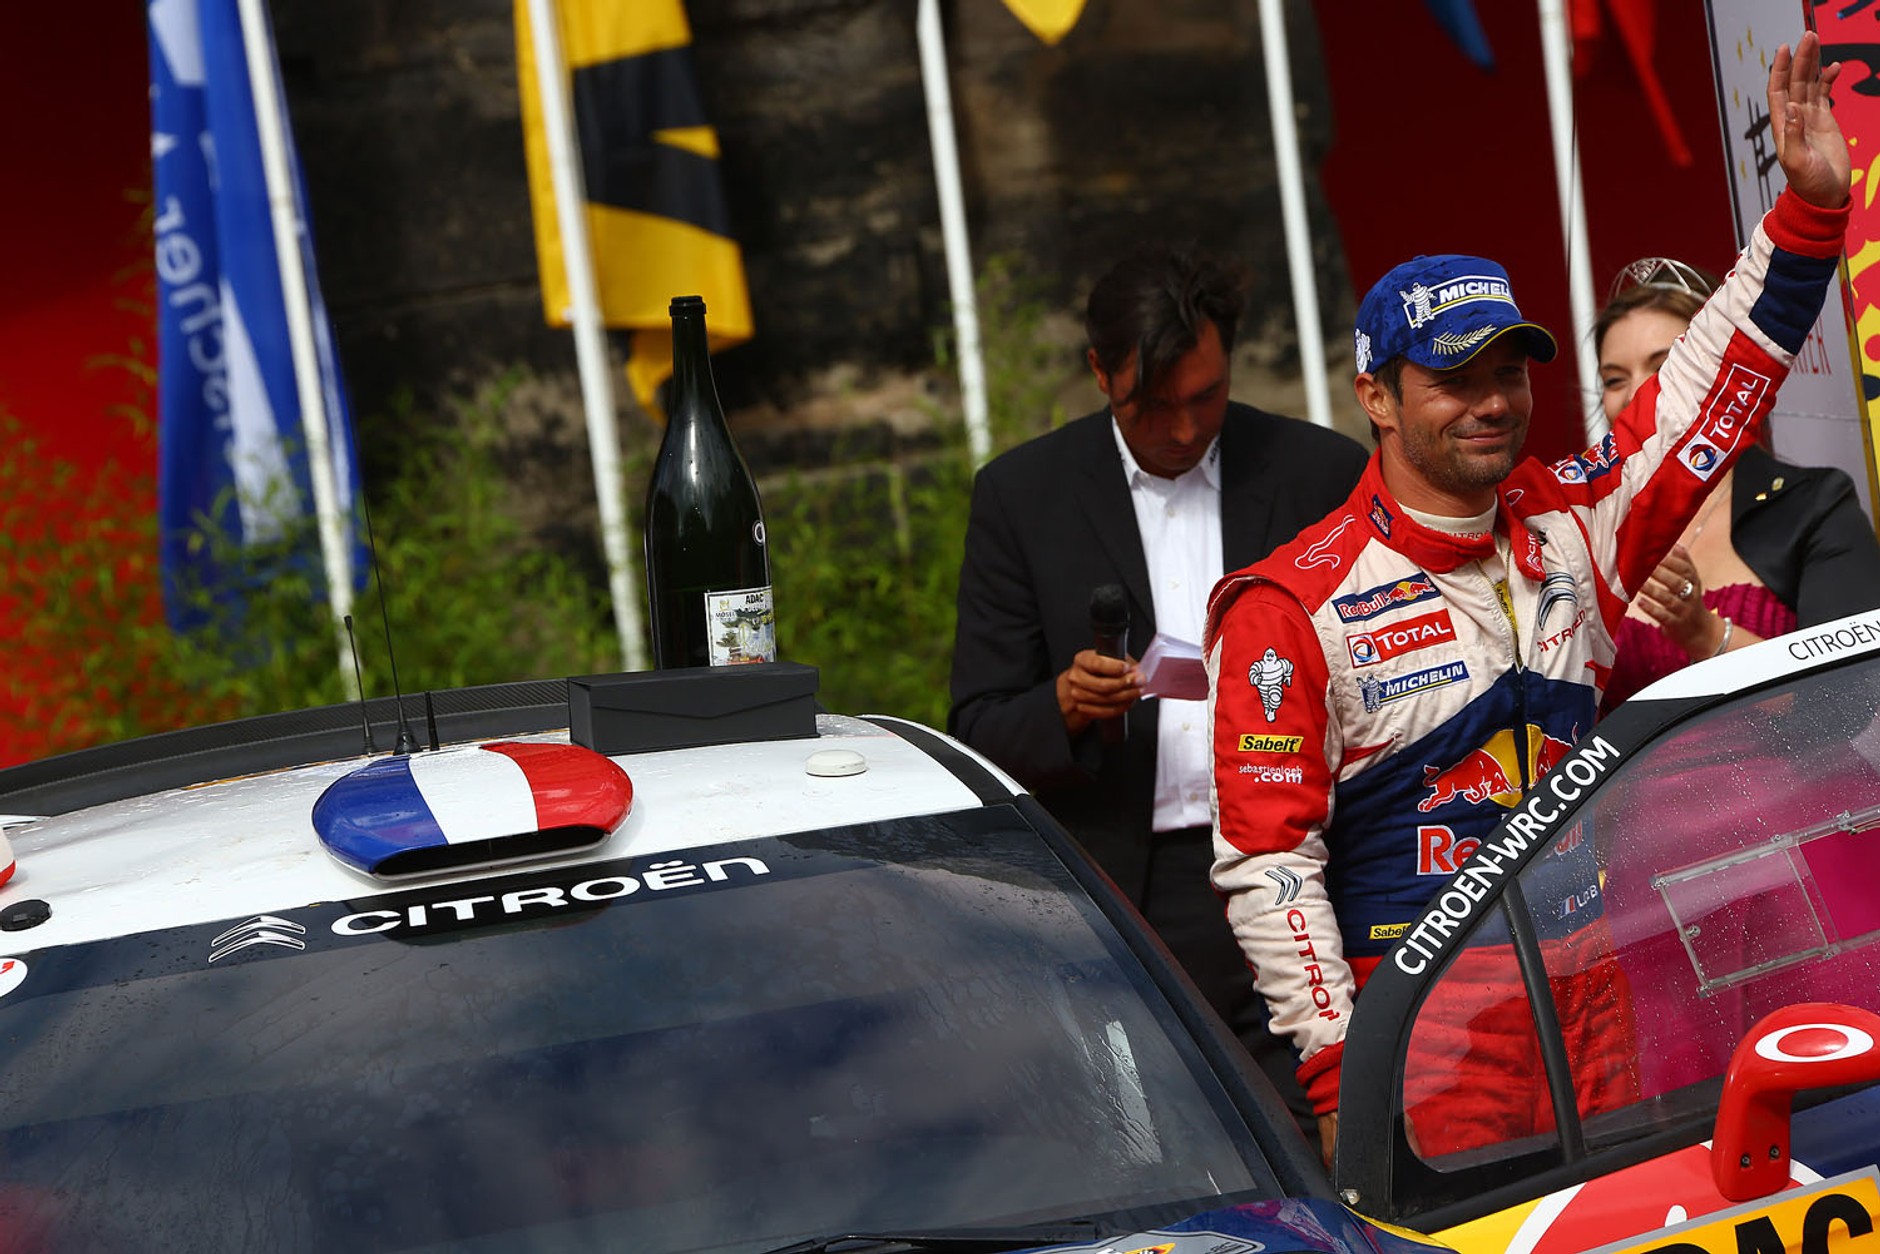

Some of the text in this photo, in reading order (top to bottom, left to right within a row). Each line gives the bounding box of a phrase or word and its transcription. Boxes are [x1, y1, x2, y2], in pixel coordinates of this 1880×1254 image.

[1711, 378, 1759, 439] TOTAL
[1376, 622, 1451, 650] TOTAL
[1386, 664, 1463, 696] MICHELIN
[1243, 736, 1299, 752] Sabelt
[1394, 735, 1621, 975] CITROEN-WRC.COM
[1417, 825, 1482, 875] Re
